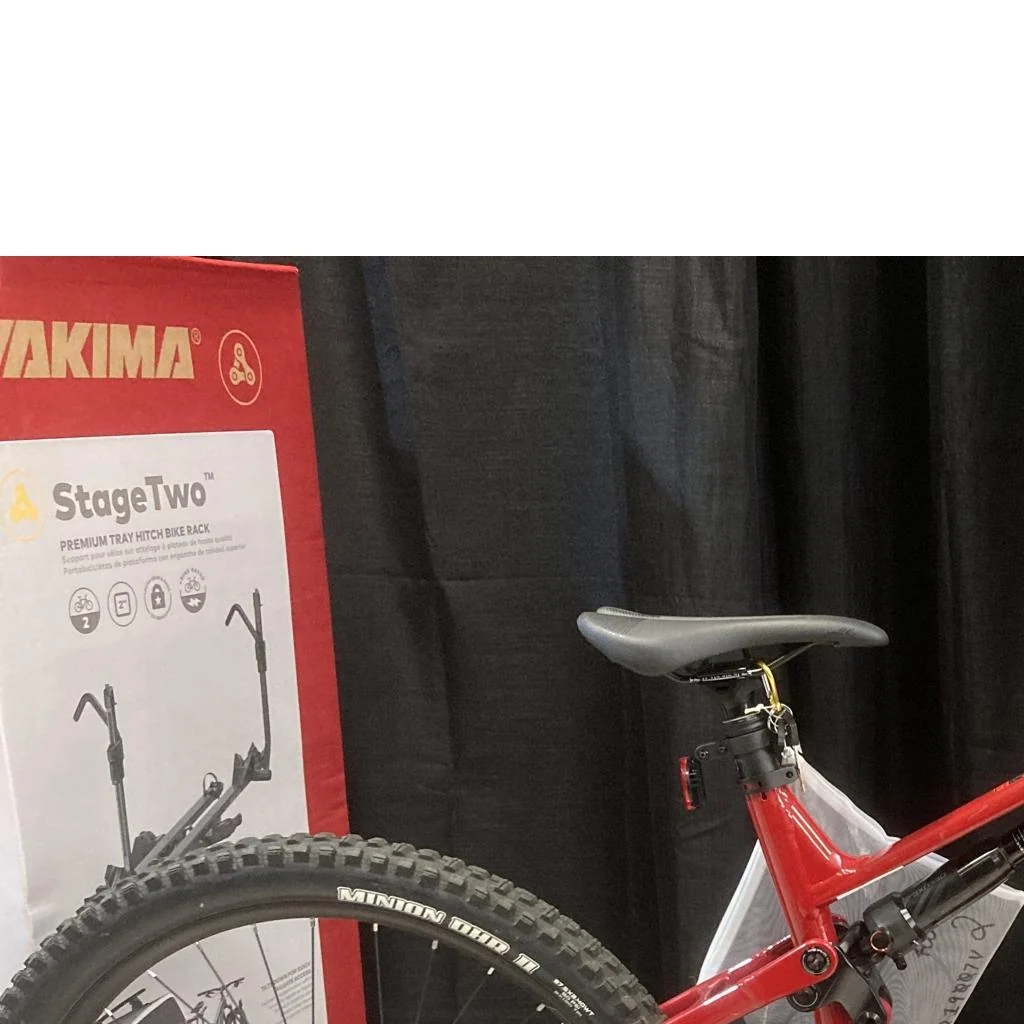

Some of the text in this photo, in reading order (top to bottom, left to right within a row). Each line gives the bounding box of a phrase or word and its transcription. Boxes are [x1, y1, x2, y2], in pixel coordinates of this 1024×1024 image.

[60, 523, 210, 551] PREMIUM TRAY HITCH BIKE RACK
[82, 616, 90, 629] 2
[337, 886, 541, 974] MINION DHR II
